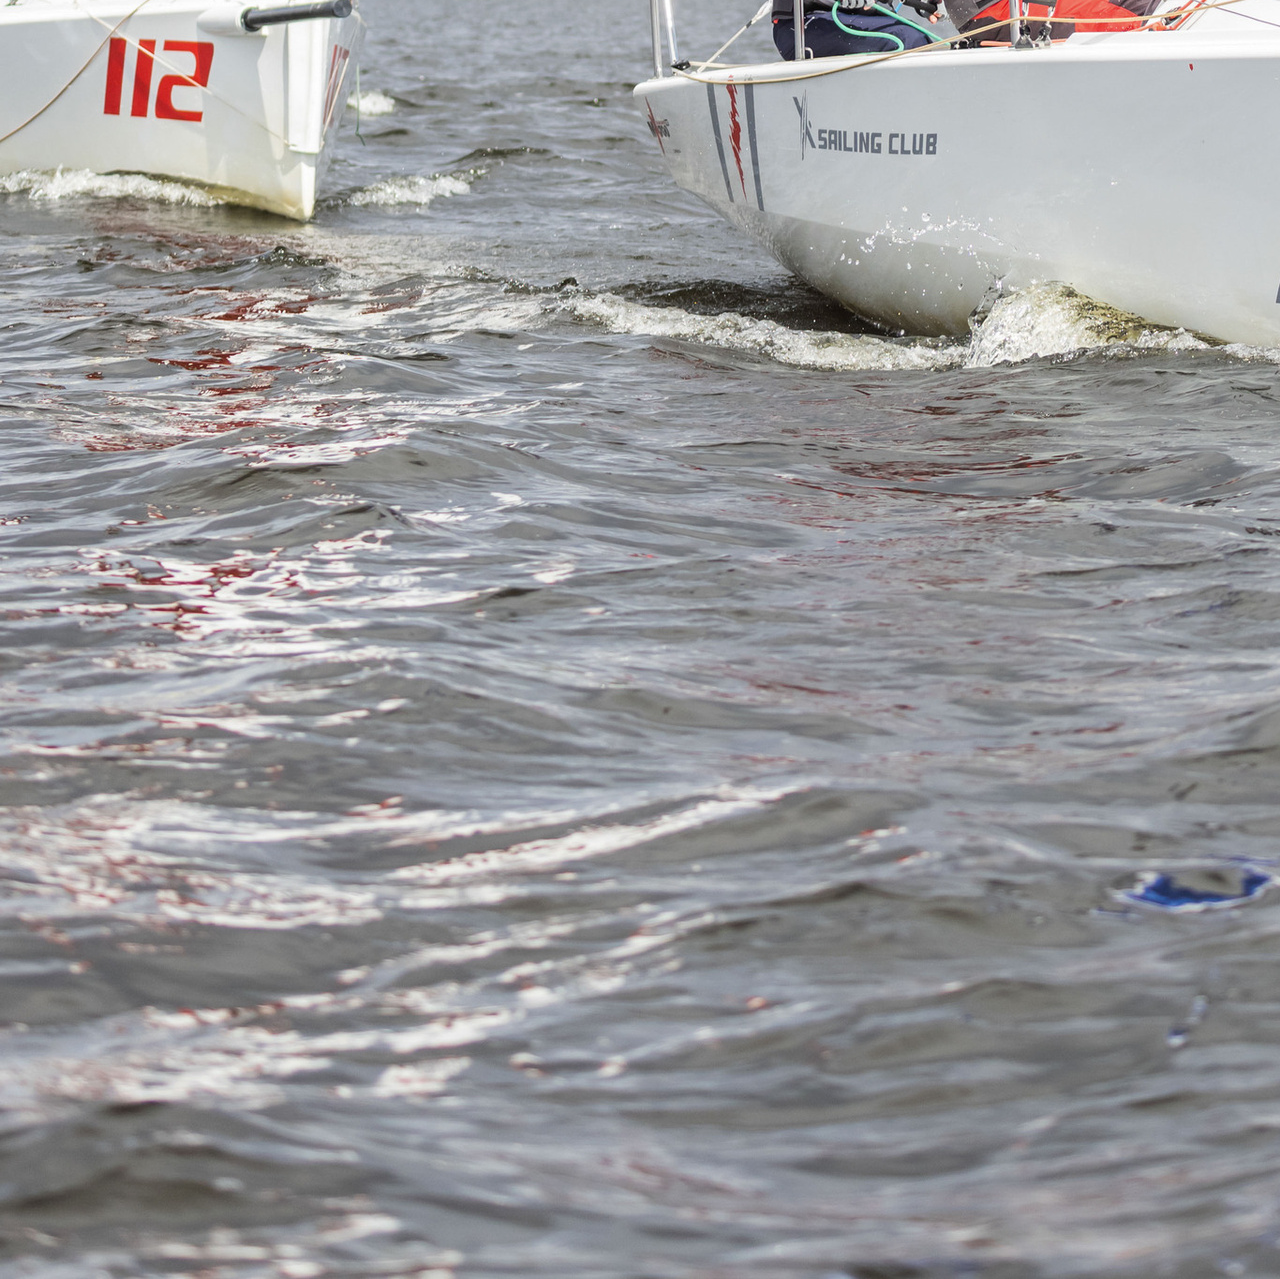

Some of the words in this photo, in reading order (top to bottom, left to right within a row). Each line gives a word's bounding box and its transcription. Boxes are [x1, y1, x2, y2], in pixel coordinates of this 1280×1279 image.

[103, 37, 215, 122] 112
[818, 129, 882, 154] SAILING
[888, 133, 938, 155] CLUB
